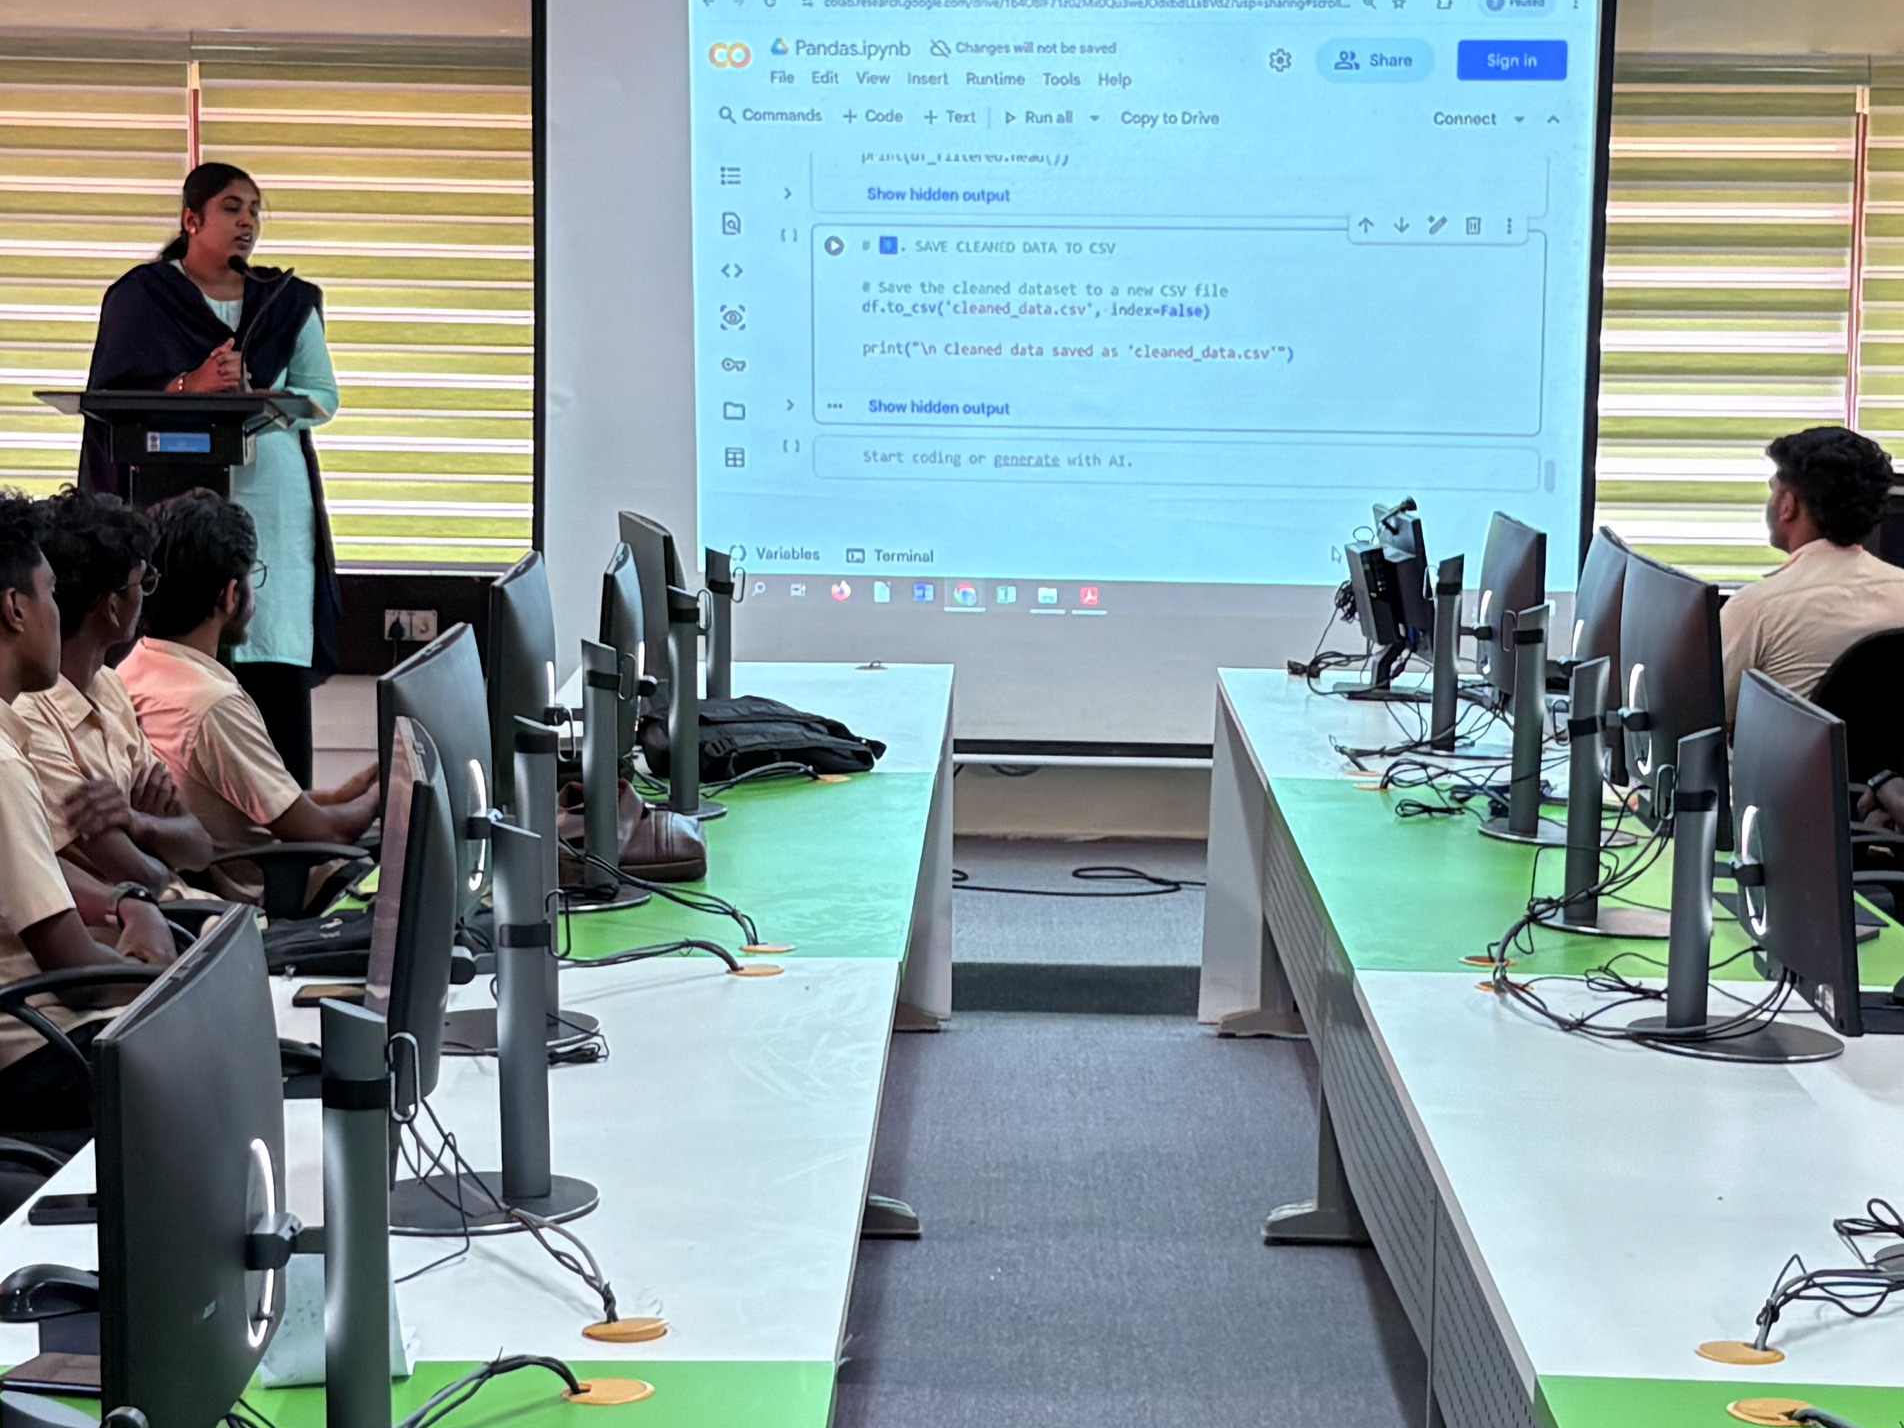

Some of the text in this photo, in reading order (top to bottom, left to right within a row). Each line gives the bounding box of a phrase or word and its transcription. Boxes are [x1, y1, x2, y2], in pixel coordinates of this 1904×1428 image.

[795, 39, 911, 60] Pandas.ipynb
[956, 42, 1117, 57] Changes will not be saved
[1370, 53, 1413, 68] Share
[1487, 54, 1537, 70] Sign in
[771, 71, 1132, 89] File Edit View Insert Runtime Tools Help
[742, 108, 823, 123] Commands
[865, 109, 903, 123] Code
[946, 110, 976, 124] Text
[1025, 111, 1073, 124] Run all
[1121, 111, 1219, 128] Copy to Drive
[1433, 112, 1496, 126] Connect
[867, 187, 1010, 204] Show hidden output
[915, 240, 948, 254] SAVE
[957, 241, 1015, 255] CLEANED
[1023, 241, 1057, 255] DATA
[1066, 242, 1082, 255] TO
[1090, 242, 1116, 256] CSV
[878, 281, 912, 295] Save
[920, 281, 945, 295] the
[953, 281, 1010, 296] cleaned
[1019, 282, 1076, 297] dataset
[1086, 283, 1102, 297] to
[1111, 286, 1119, 297] a
[1127, 286, 1153, 297] new
[1160, 284, 1187, 298] CSV
[1195, 283, 1228, 299] file
[1110, 303, 1210, 320] index=False)
[944, 342, 1002, 357] Cleaned
[1010, 342, 1044, 357] data
[1052, 343, 1094, 358] saved
[1102, 347, 1119, 359] as
[869, 400, 1010, 417] Show hidden output
[863, 450, 1133, 468] Start coding or generate with AI.
[756, 547, 820, 561] Variables
[874, 549, 934, 563] Terminal
